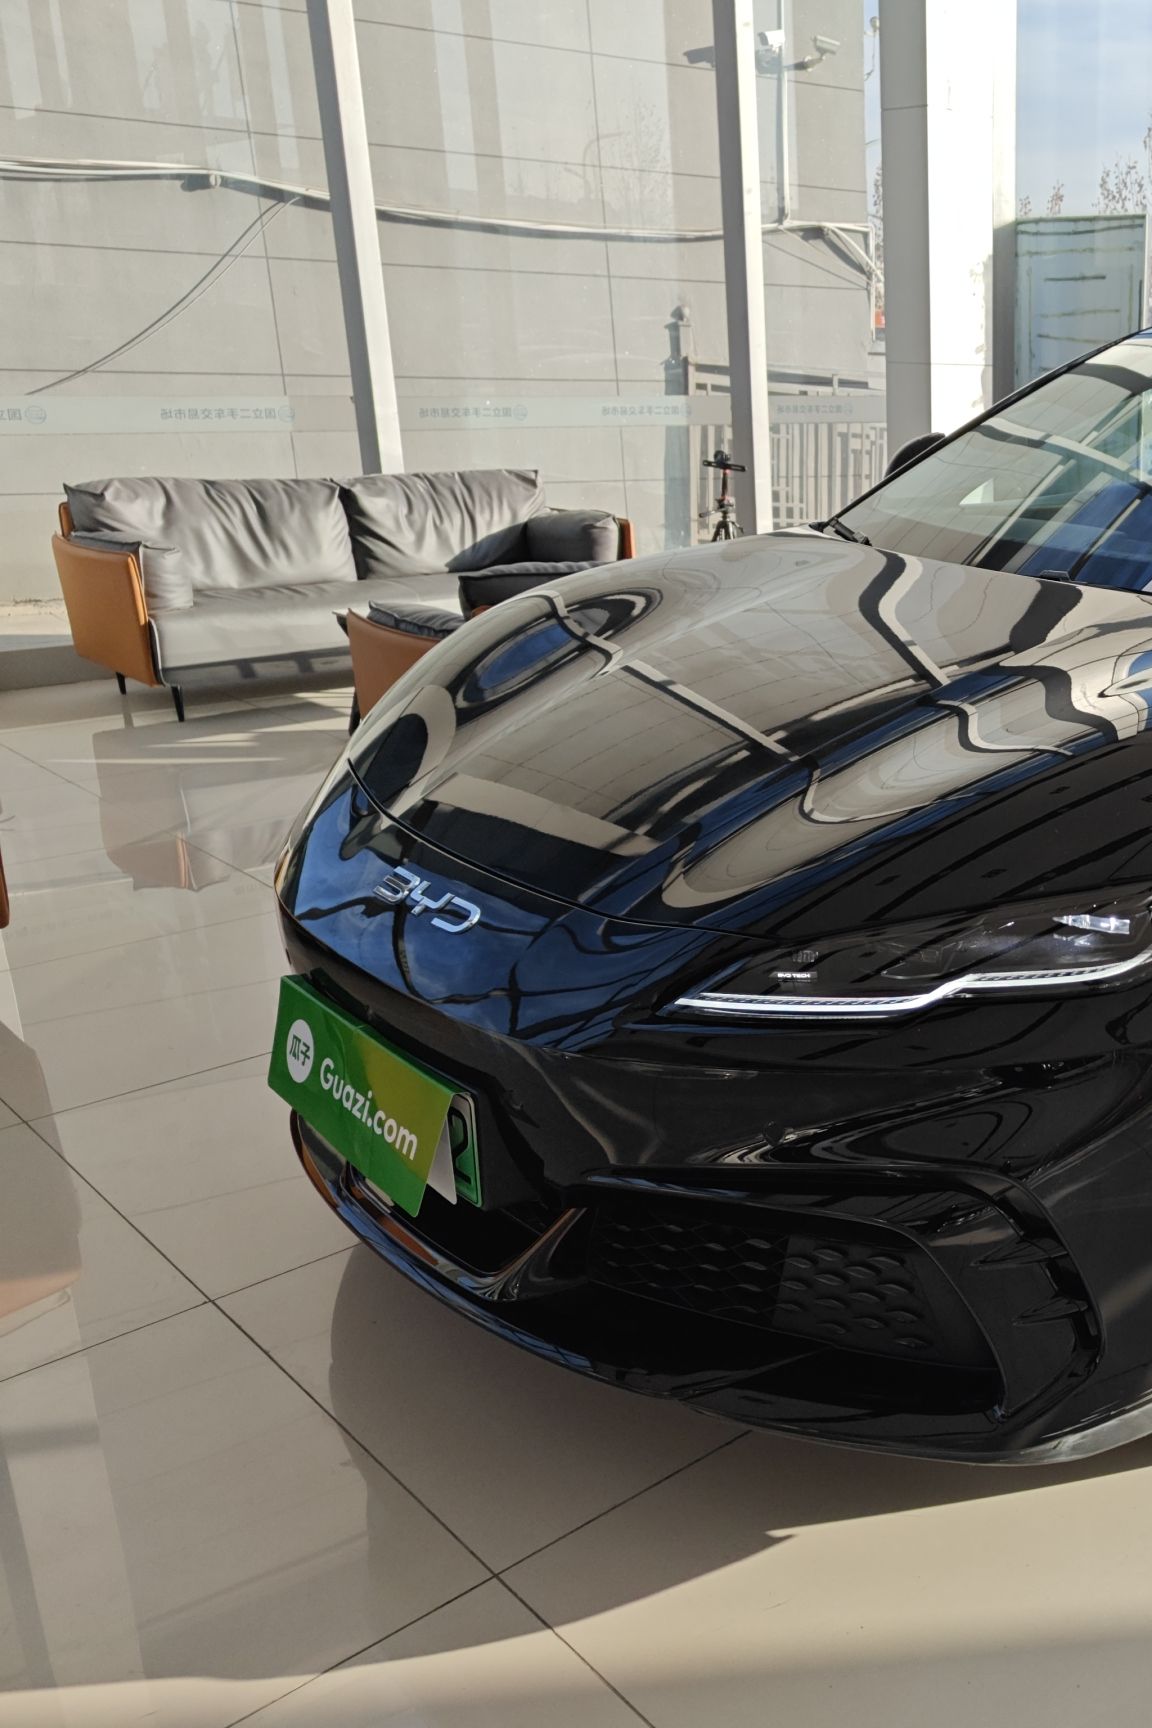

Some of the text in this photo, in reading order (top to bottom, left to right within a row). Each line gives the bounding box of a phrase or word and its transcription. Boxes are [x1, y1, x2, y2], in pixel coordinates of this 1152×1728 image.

[373, 866, 481, 933] BYD
[289, 1034, 311, 1067] 瓜子
[320, 1057, 418, 1161] Guazi.com
